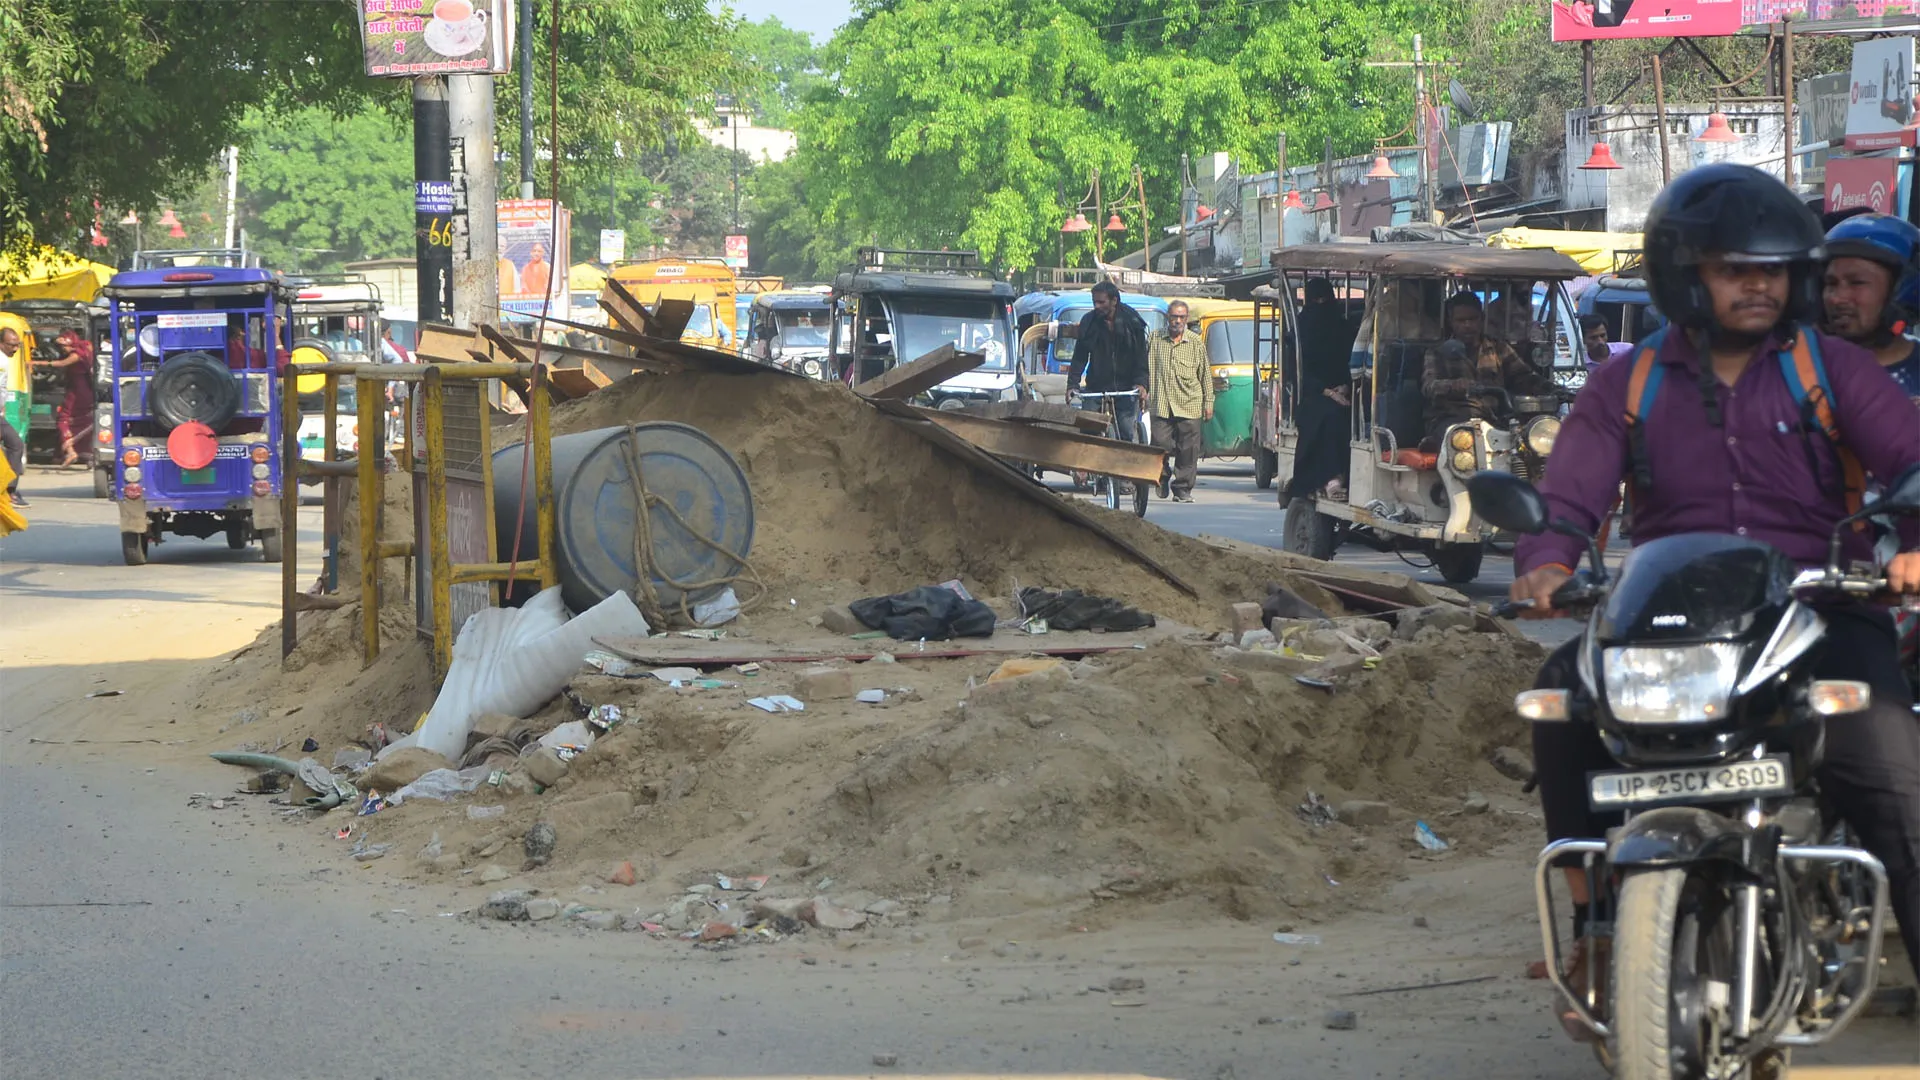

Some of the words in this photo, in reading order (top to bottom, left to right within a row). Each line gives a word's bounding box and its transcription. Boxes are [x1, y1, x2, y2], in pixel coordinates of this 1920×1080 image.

[368, 22, 391, 34] शहर
[395, 17, 424, 33] बरेली
[393, 39, 406, 55] में
[429, 217, 452, 247] 66
[1618, 777, 1645, 797] UP
[1657, 770, 1711, 794] 25CX
[1722, 766, 1779, 788] 2609
